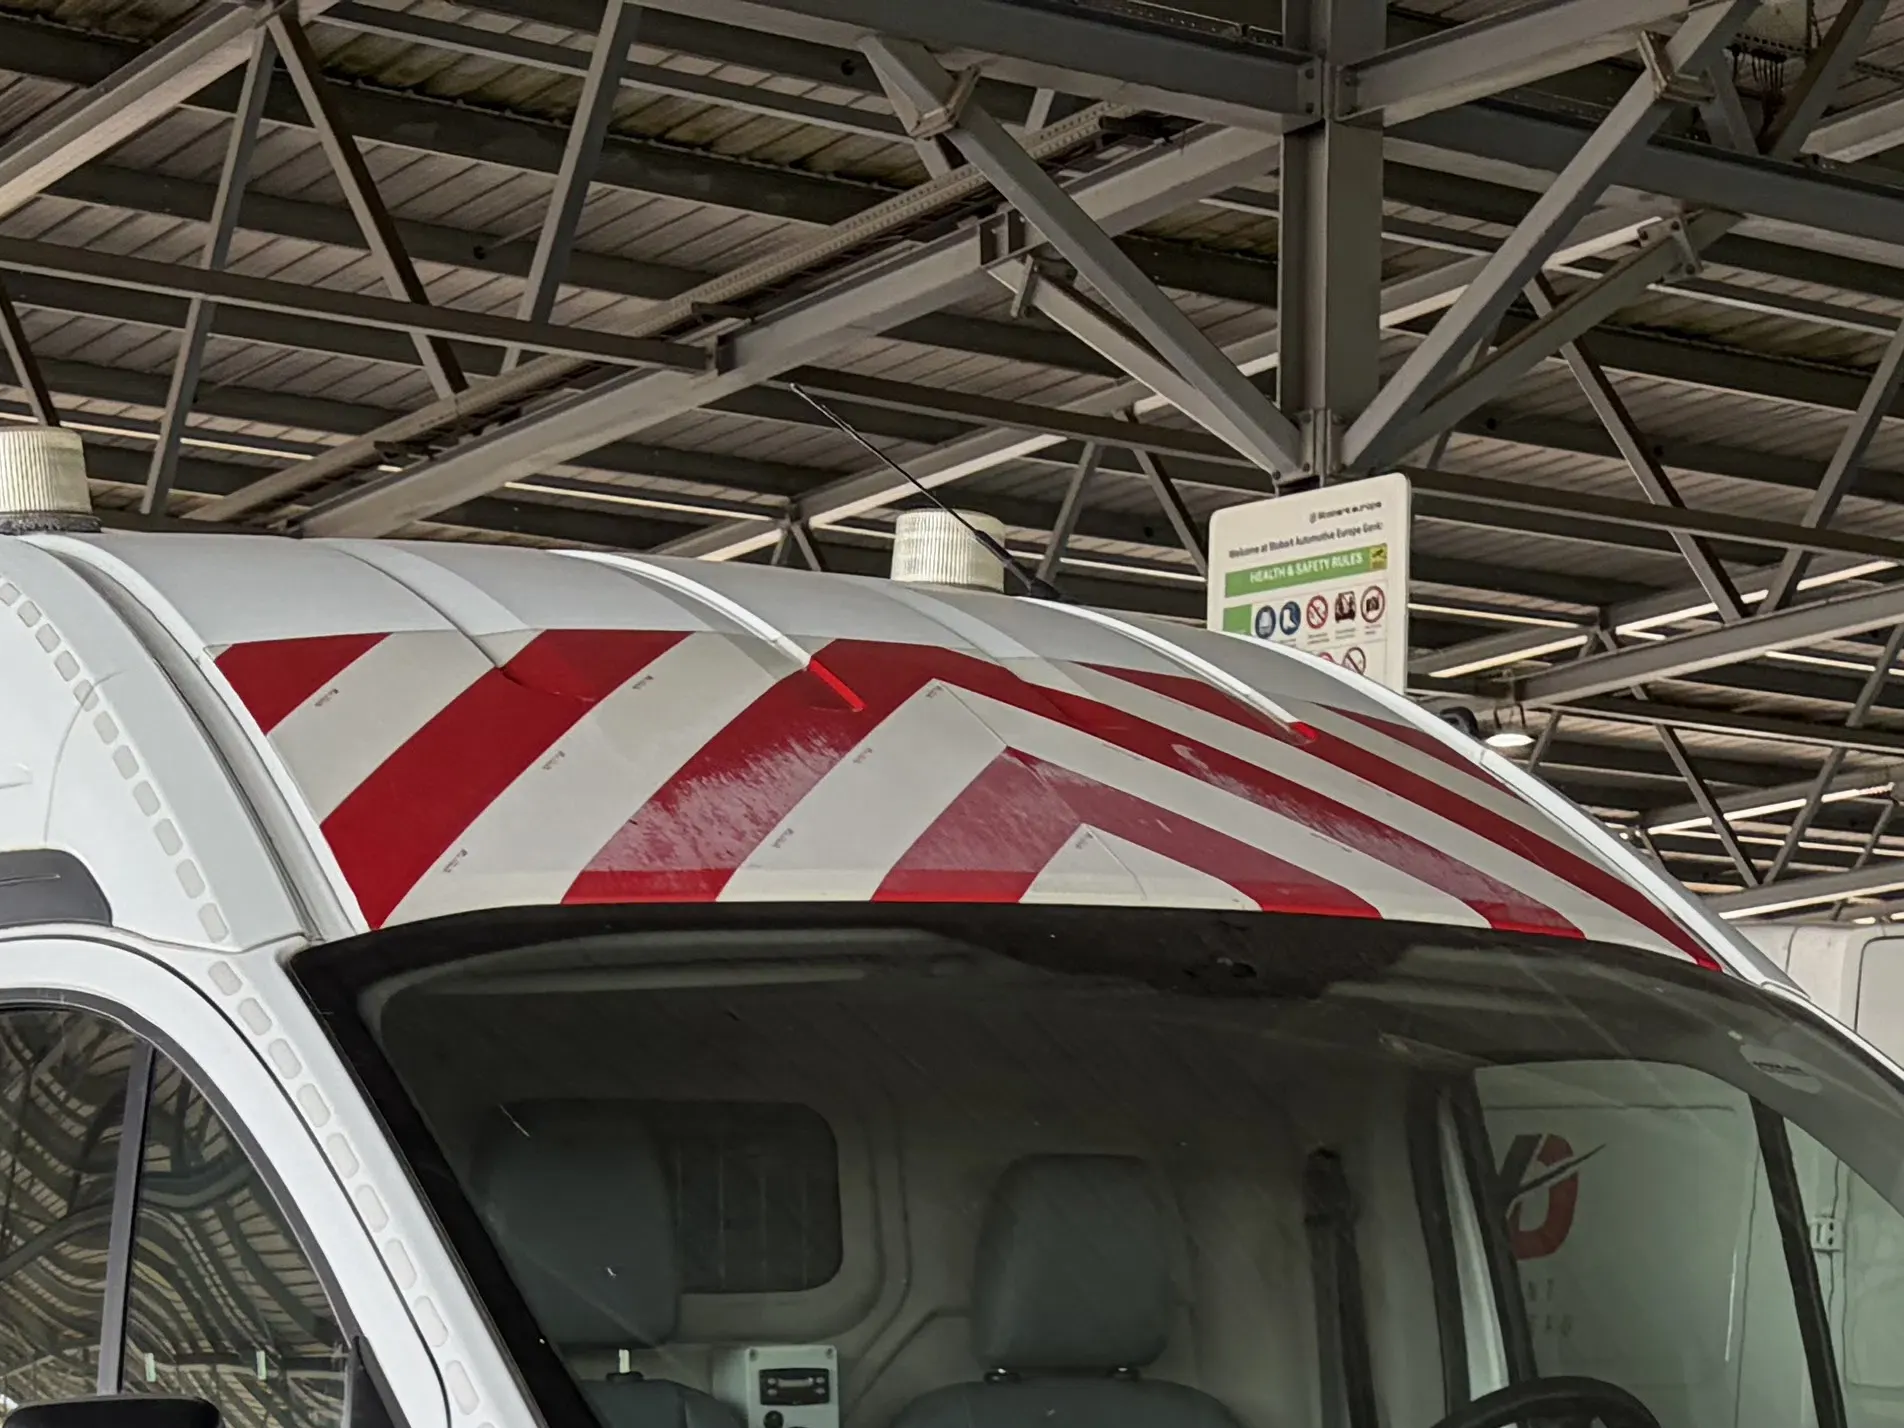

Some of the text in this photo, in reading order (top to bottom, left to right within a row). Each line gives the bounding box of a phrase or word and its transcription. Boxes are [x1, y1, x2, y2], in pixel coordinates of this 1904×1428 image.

[1250, 567, 1287, 584] HEALTH
[1287, 566, 1295, 578] &
[1295, 558, 1330, 577] SAFETY
[1331, 552, 1365, 569] RULES
